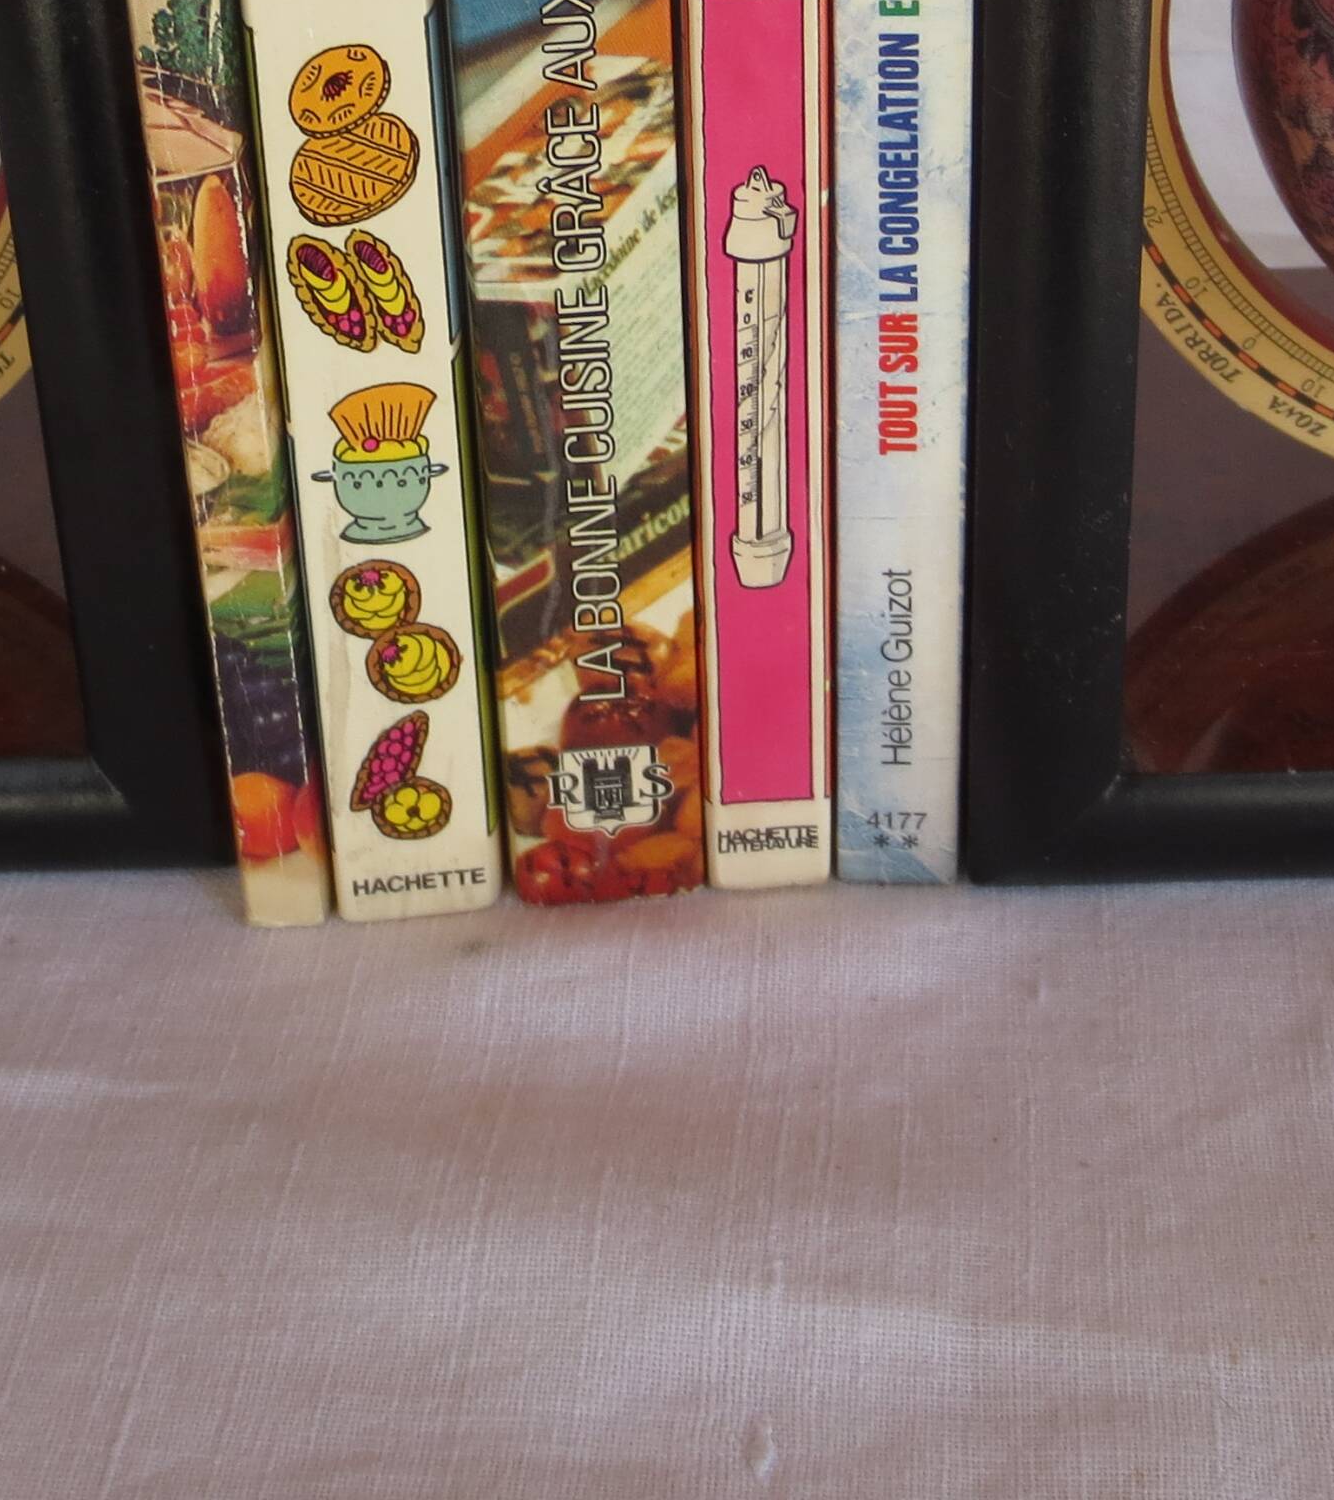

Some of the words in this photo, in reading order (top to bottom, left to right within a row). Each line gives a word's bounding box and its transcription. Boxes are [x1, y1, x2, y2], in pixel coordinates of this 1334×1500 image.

[878, 33, 919, 256] CONGELATION
[537, 103, 607, 273] GRÂCE
[878, 265, 918, 302] LA
[555, 285, 616, 465] CUISINE
[878, 314, 919, 373] SUR
[878, 381, 918, 455] TOUT
[1268, 395, 1328, 438] ZONA
[569, 475, 624, 634] BONNE
[880, 568, 913, 662] Guizot
[576, 642, 625, 702] LA
[881, 669, 913, 766] Hélène
[639, 763, 675, 800] S
[867, 811, 927, 829] 4177
[352, 868, 487, 896] HACHETTE
